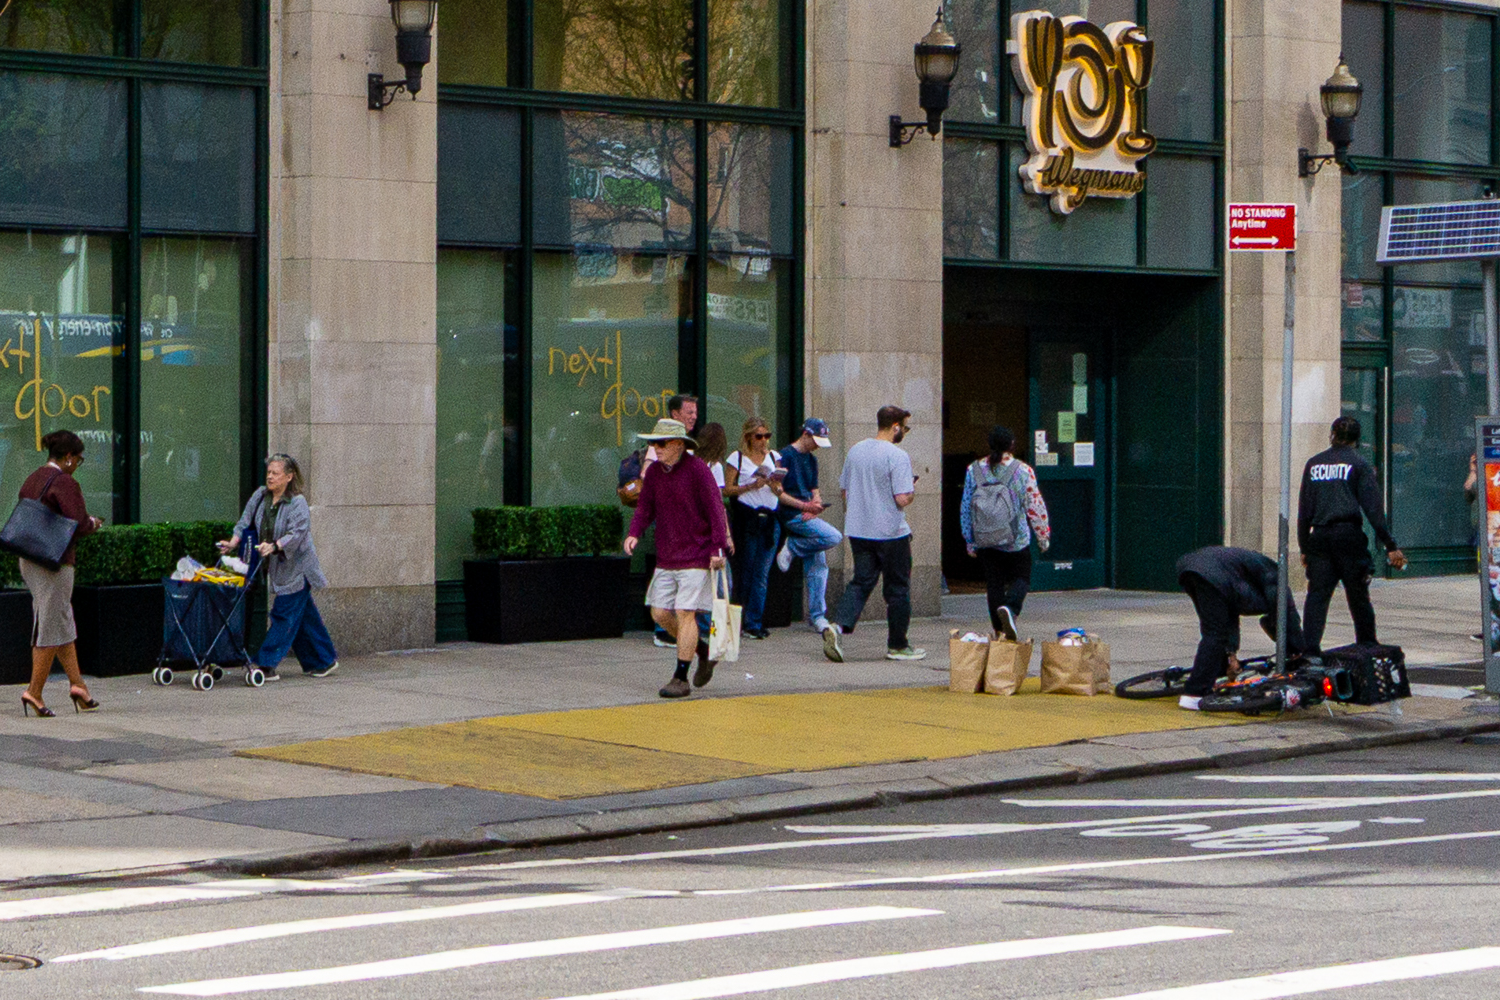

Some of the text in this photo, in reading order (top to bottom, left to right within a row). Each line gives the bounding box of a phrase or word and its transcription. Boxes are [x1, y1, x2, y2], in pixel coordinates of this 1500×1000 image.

[1036, 145, 1148, 209] Wegmans
[1231, 208, 1286, 218] NO STANDING
[1231, 219, 1267, 230] Anytime
[548, 336, 614, 387] next
[14, 318, 111, 452] door
[1310, 462, 1353, 482] SECURITY
